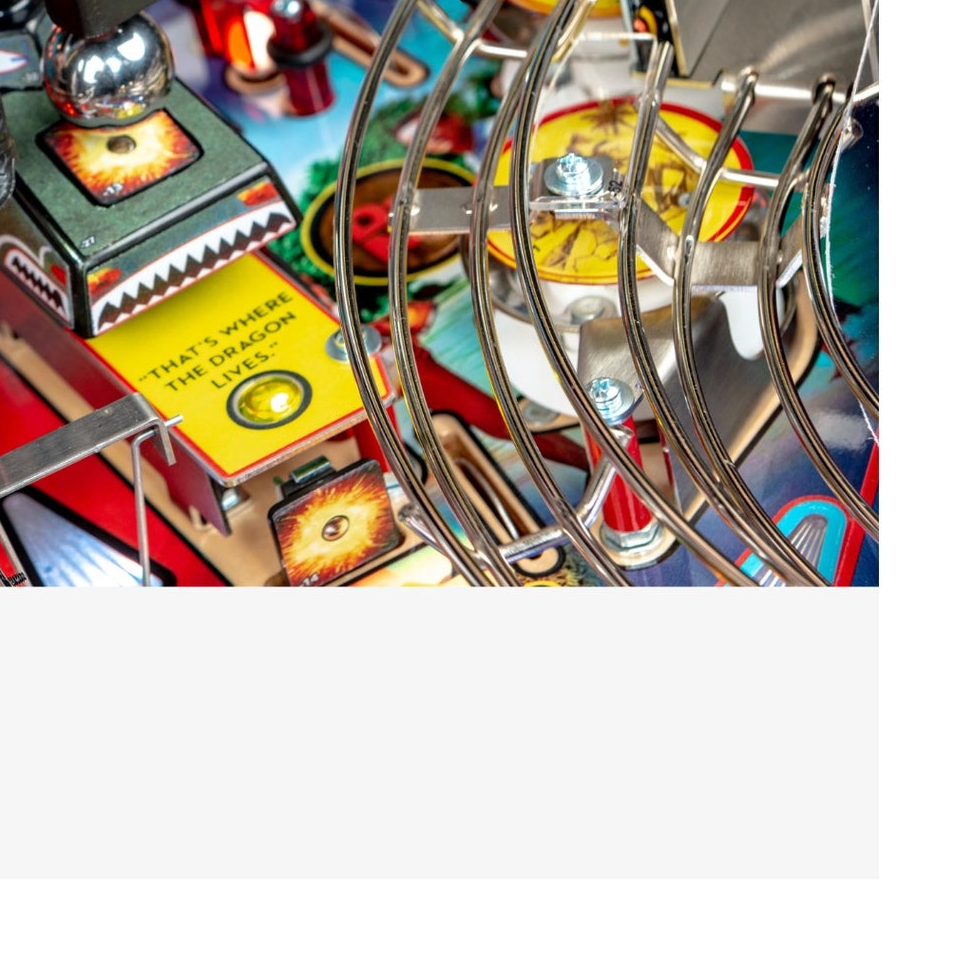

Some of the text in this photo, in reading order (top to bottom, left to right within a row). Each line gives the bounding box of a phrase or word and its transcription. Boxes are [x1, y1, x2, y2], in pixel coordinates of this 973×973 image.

[219, 291, 293, 336] WHERE
[165, 311, 296, 391] THE DRAGON
[211, 341, 278, 389] LIVES."
